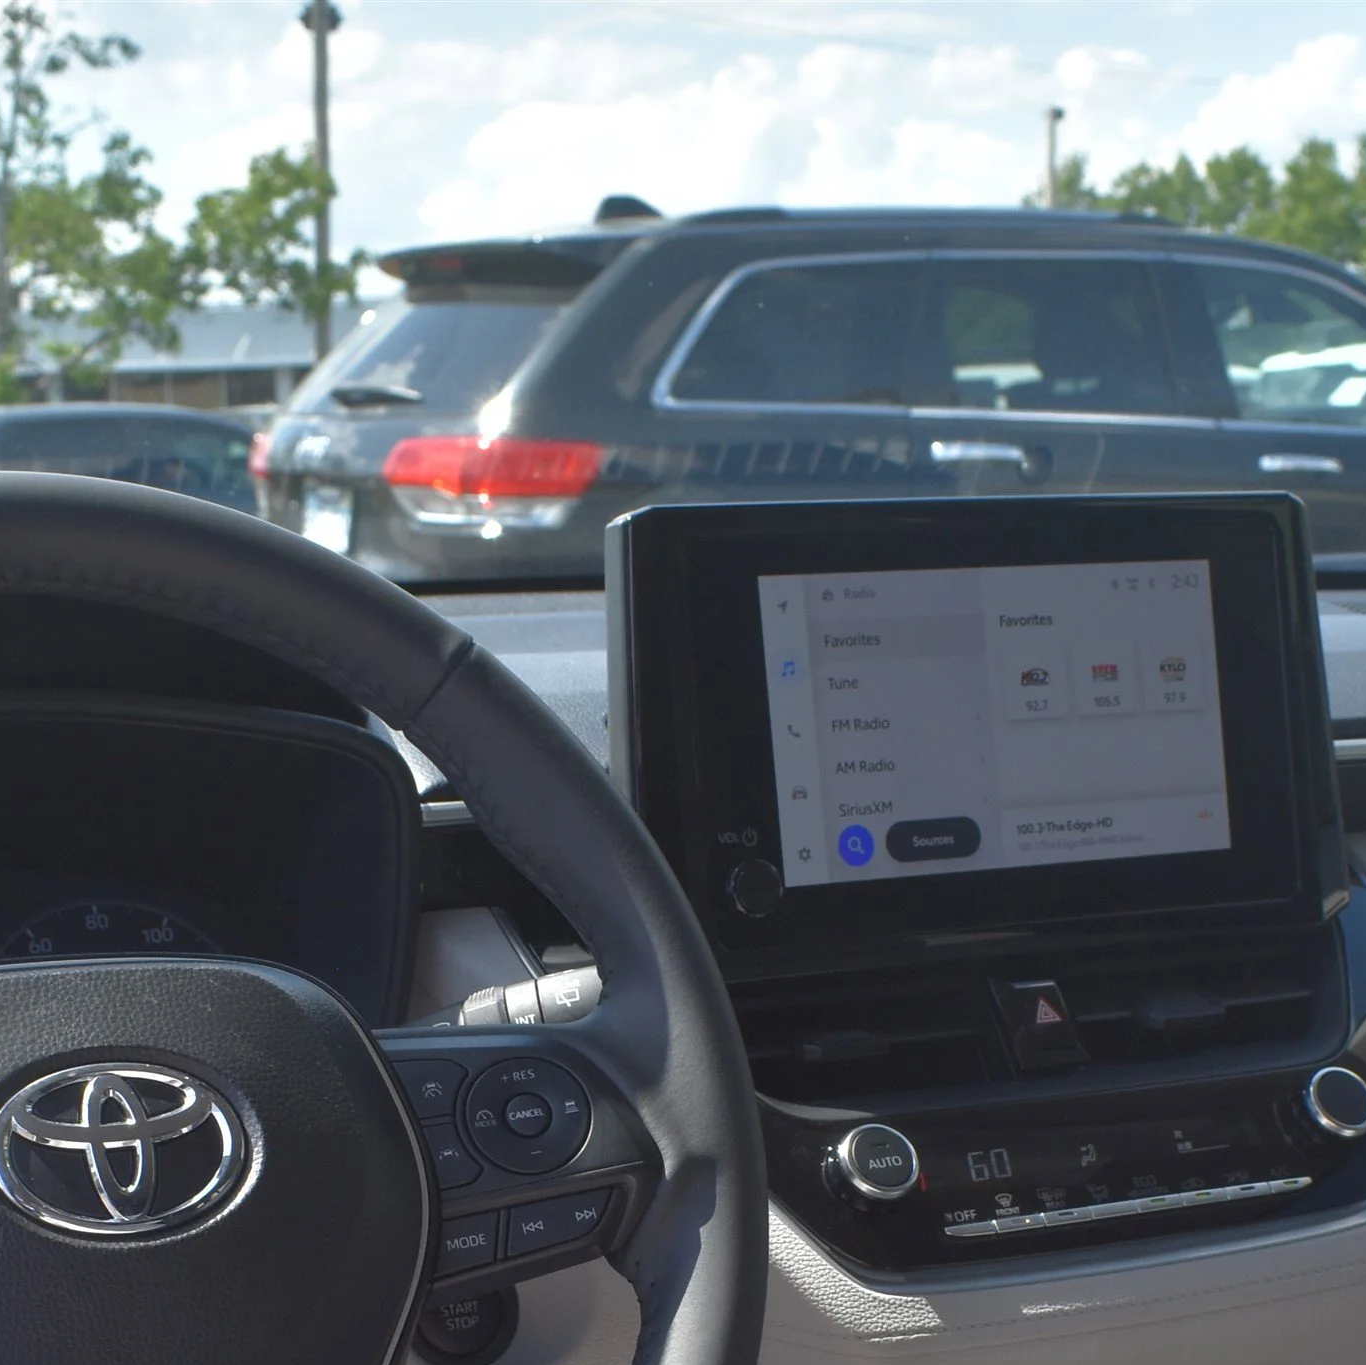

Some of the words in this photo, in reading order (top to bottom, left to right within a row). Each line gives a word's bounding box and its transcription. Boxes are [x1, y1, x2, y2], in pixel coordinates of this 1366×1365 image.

[1171, 574, 1200, 588] 2:43
[843, 587, 877, 600] Radio
[999, 613, 1054, 628] Favorites
[824, 633, 881, 648] Favorites
[828, 677, 859, 690] Tune
[1025, 700, 1049, 711] 92.7
[1094, 695, 1121, 707] 105.5
[1164, 692, 1187, 704] 97.9
[832, 719, 850, 732] FM
[854, 716, 891, 731] Radio
[835, 761, 855, 774] AM
[859, 758, 895, 773] Radio
[839, 801, 893, 817] SiriusXM
[913, 834, 955, 848] Sources
[85, 912, 110, 931] 80
[141, 926, 174, 944] 100
[27, 936, 53, 955] 60
[512, 1068, 536, 1082] RES
[508, 1107, 545, 1122] CANCEL
[868, 1156, 902, 1170] AUTO
[966, 1147, 1013, 1182] 60
[953, 1208, 978, 1222] OFF
[995, 1206, 1021, 1218] FRONT
[446, 1232, 488, 1251] MODE
[439, 1299, 480, 1318] START
[444, 1314, 480, 1332] STOP
